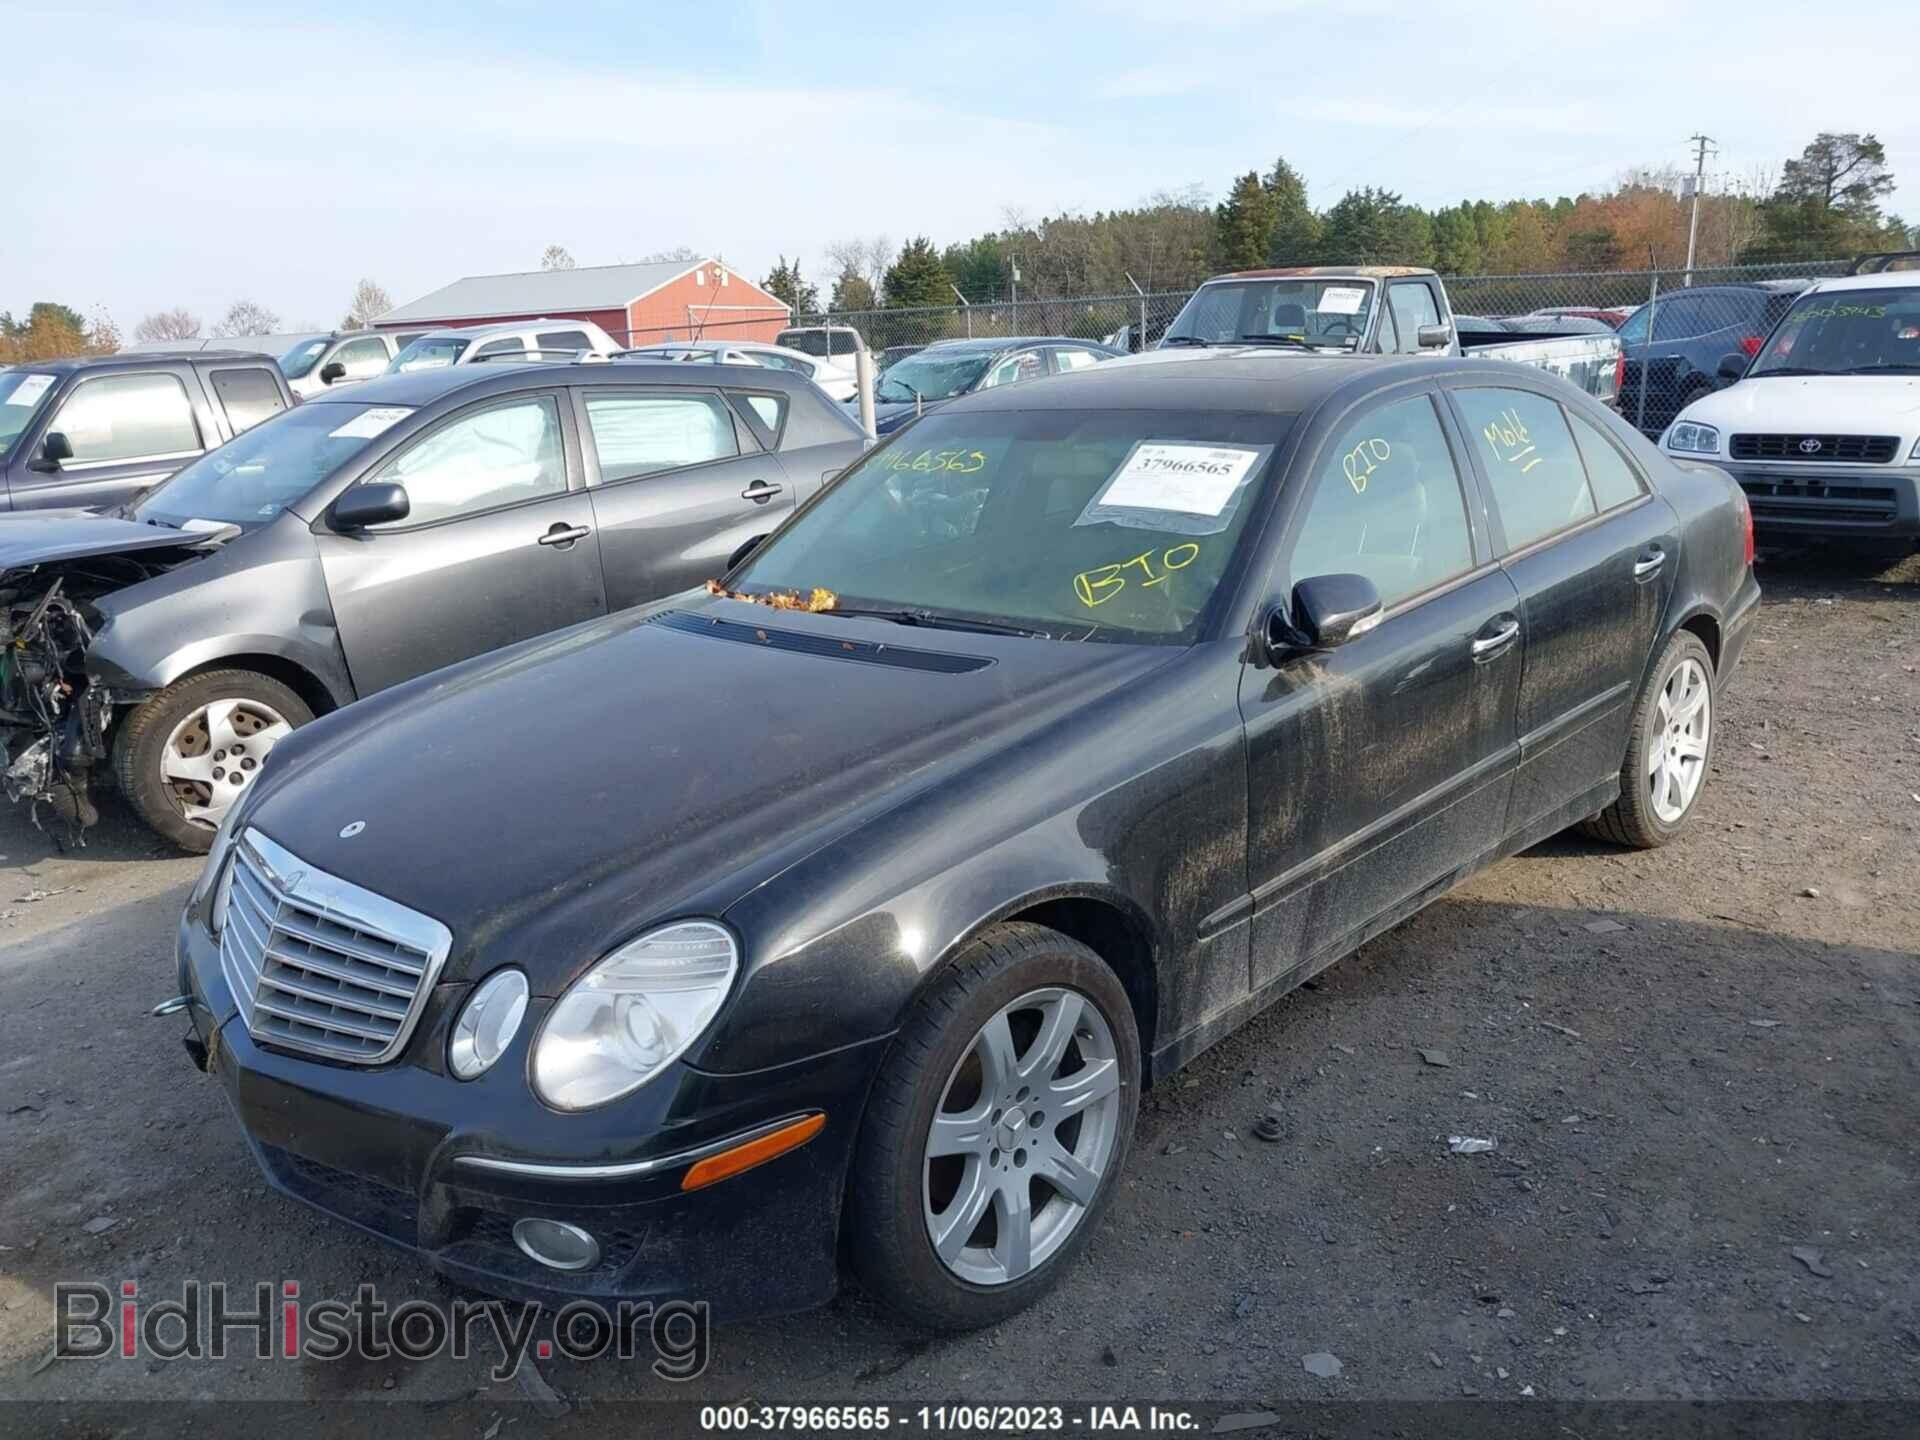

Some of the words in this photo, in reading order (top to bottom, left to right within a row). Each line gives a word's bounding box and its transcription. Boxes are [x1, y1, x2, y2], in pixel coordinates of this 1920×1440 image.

[1137, 458, 1234, 476] 37966565
[1343, 438, 1391, 494] BIO
[1073, 543, 1199, 608] BIO
